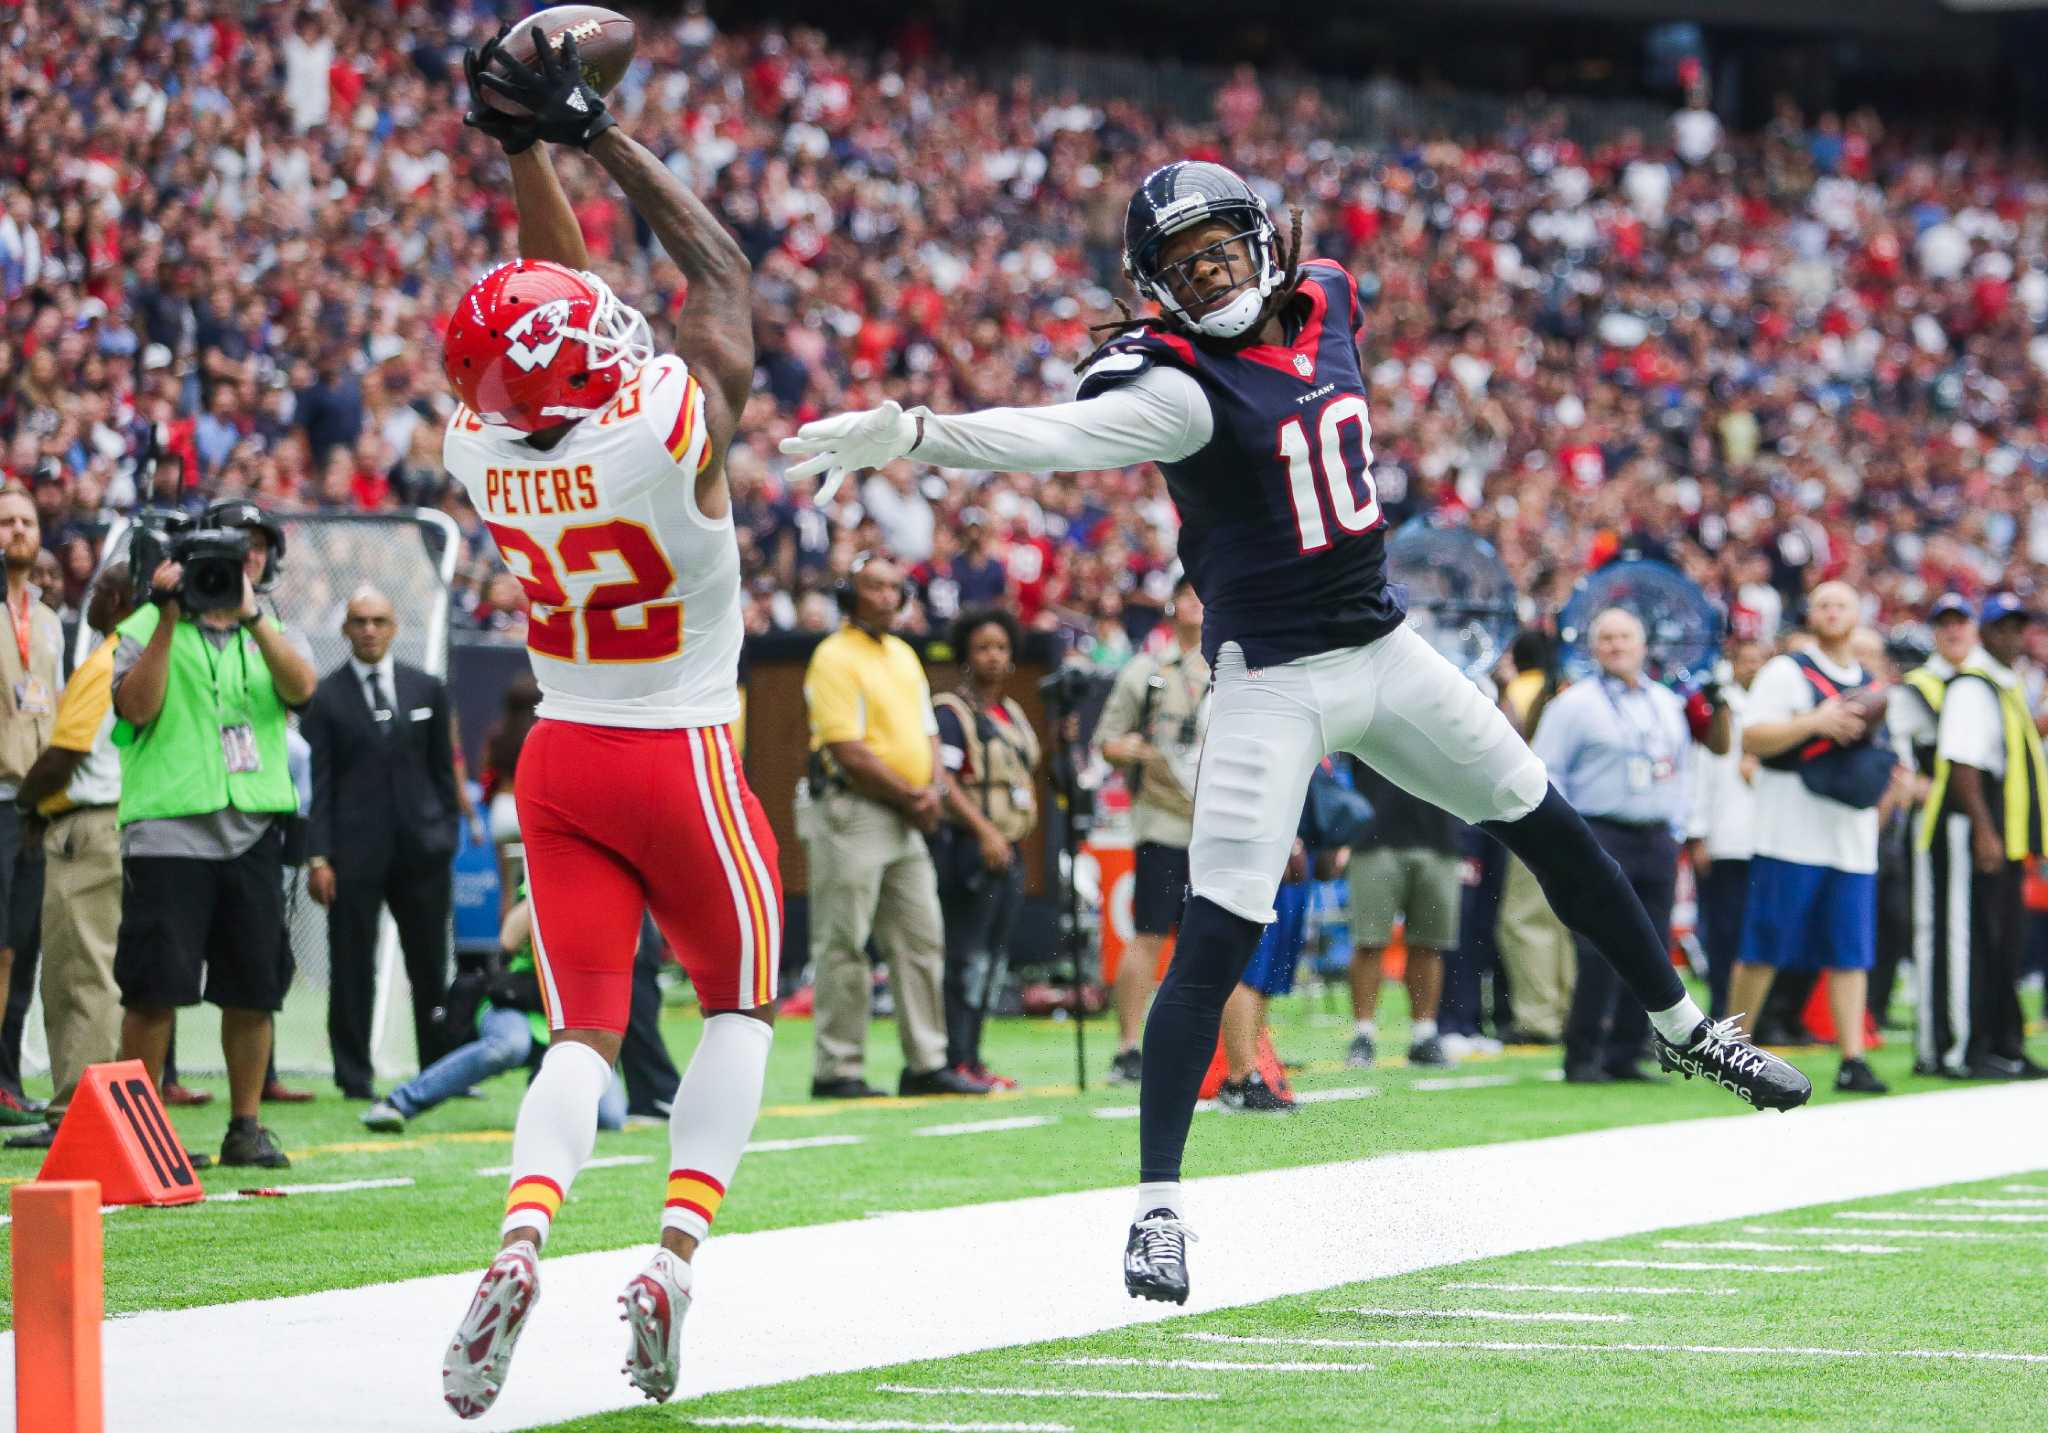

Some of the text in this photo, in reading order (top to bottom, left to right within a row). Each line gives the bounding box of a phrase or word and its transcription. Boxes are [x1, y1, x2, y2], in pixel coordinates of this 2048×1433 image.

[1296, 382, 1336, 405] TEXANS
[486, 464, 599, 515] PETERS
[1276, 392, 1385, 553] 10
[484, 516, 685, 665] 22
[1665, 1046, 1753, 1104] adidas
[109, 1079, 194, 1189] 10
